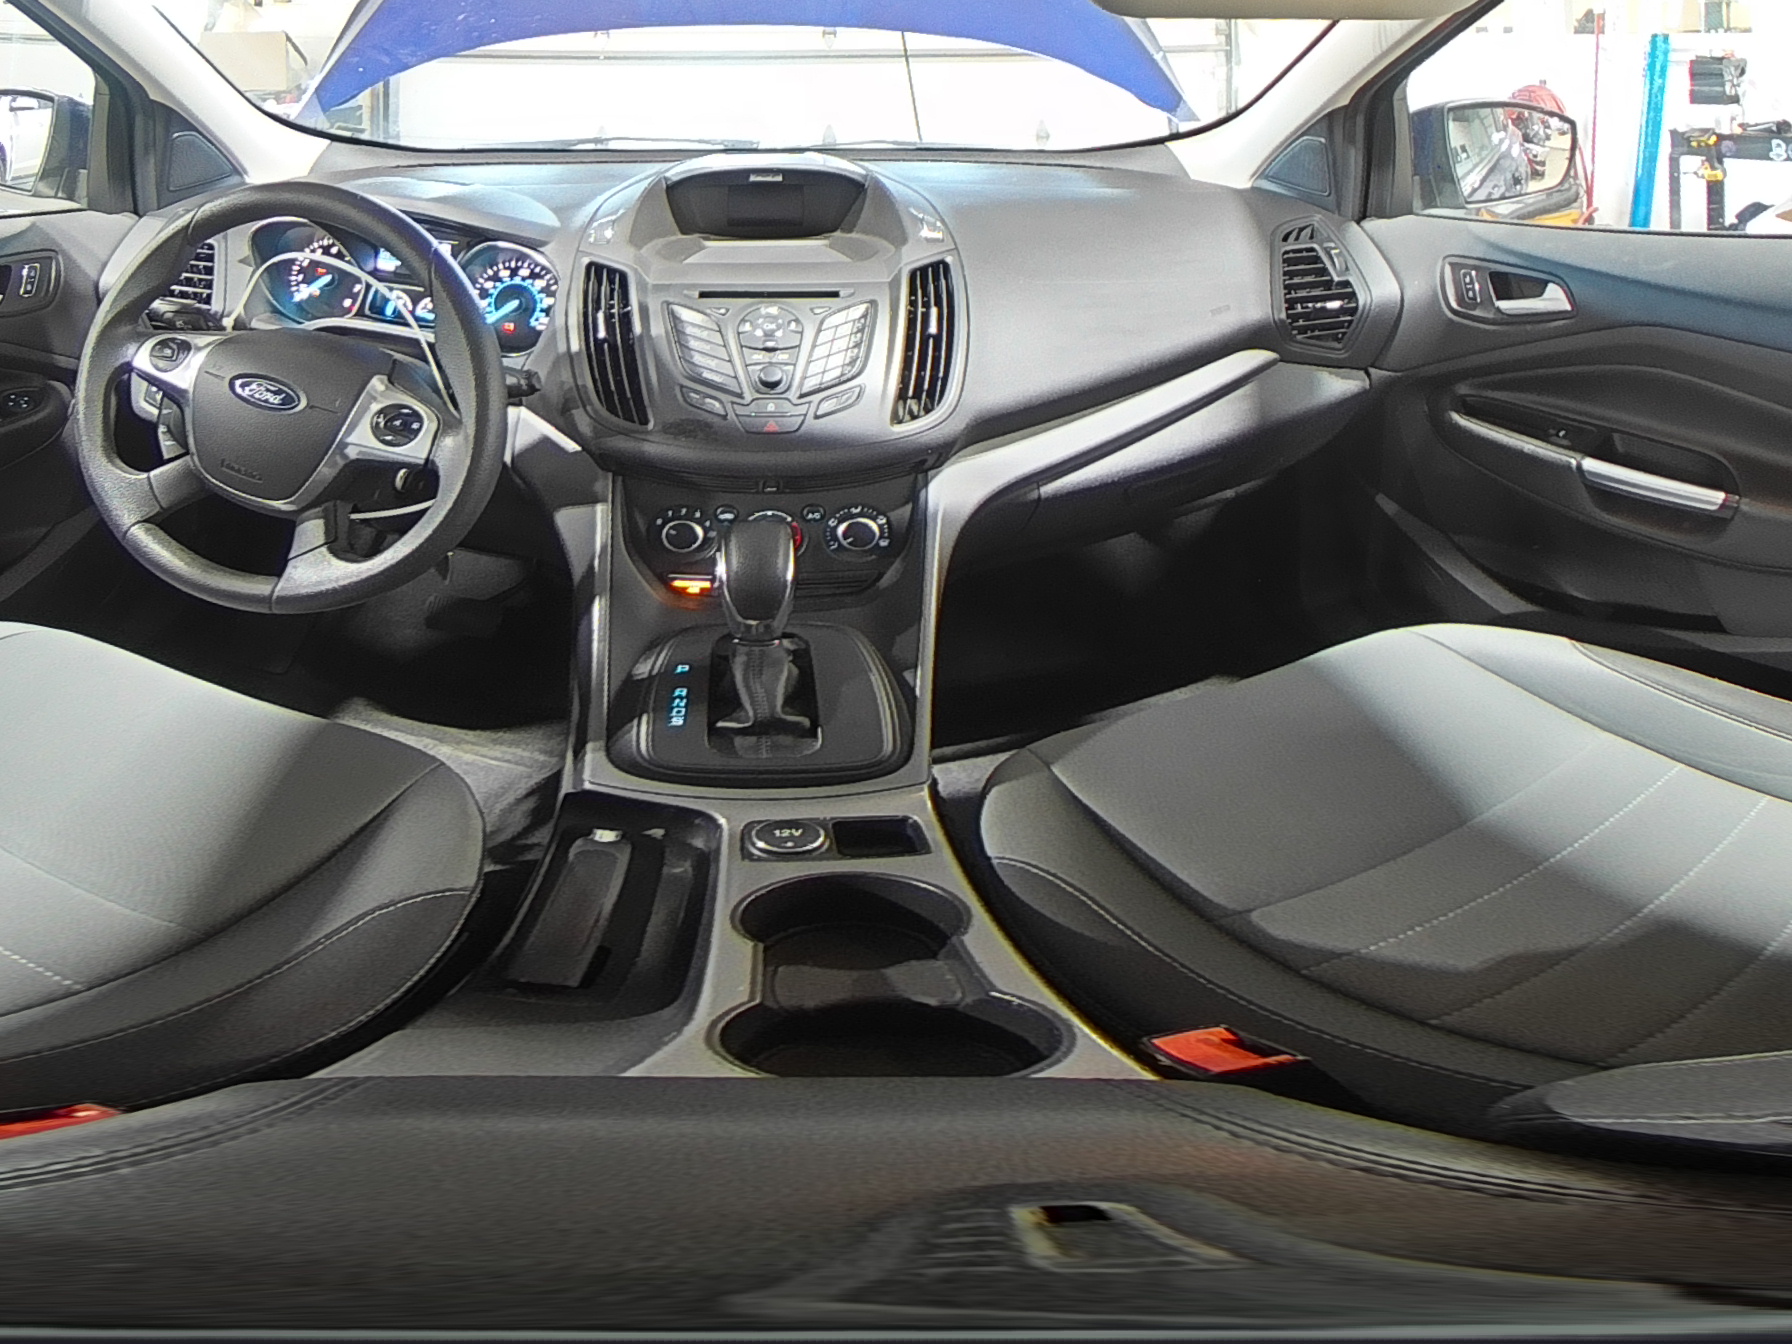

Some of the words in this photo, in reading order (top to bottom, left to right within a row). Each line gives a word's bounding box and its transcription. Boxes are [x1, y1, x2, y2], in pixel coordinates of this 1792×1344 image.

[243, 381, 286, 404] Ford
[674, 664, 690, 674] P
[672, 687, 688, 697] R
[671, 698, 687, 707] N
[669, 707, 686, 716] D
[773, 828, 803, 838] 12V
